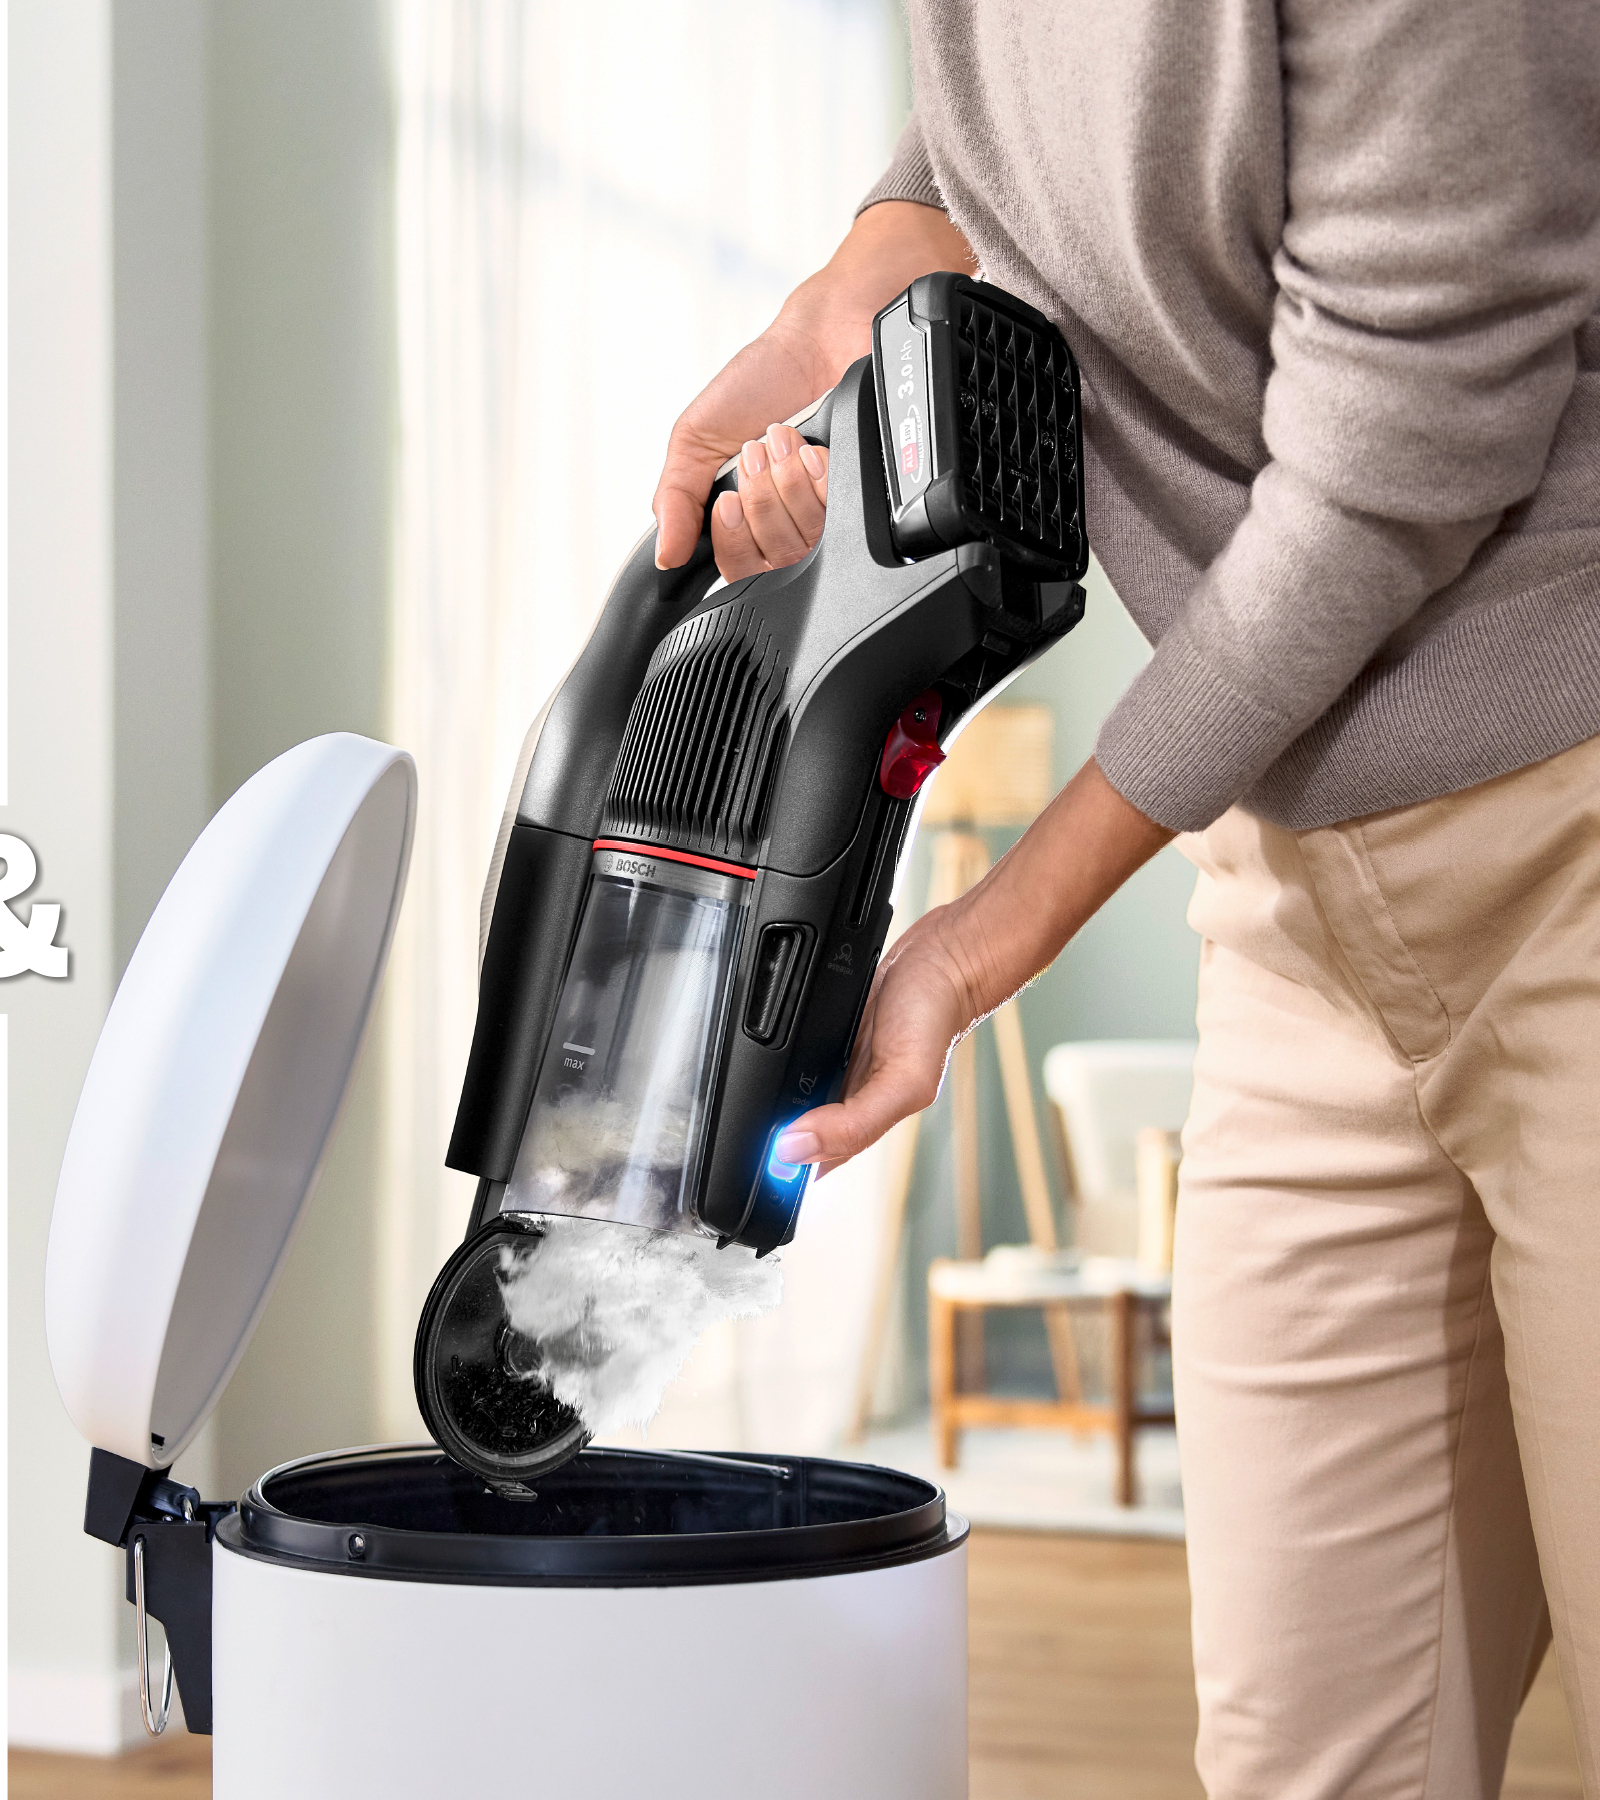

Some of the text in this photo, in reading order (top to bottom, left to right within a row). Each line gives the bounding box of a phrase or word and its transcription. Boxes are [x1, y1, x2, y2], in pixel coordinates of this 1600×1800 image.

[898, 339, 914, 399] 3.0 Ah
[904, 424, 912, 442] 18V
[916, 422, 925, 459] ALLIANCE
[905, 447, 913, 468] ALL
[615, 858, 657, 879] BOSCH
[827, 962, 854, 976] release
[564, 1056, 585, 1071] max
[792, 1097, 811, 1107] open
